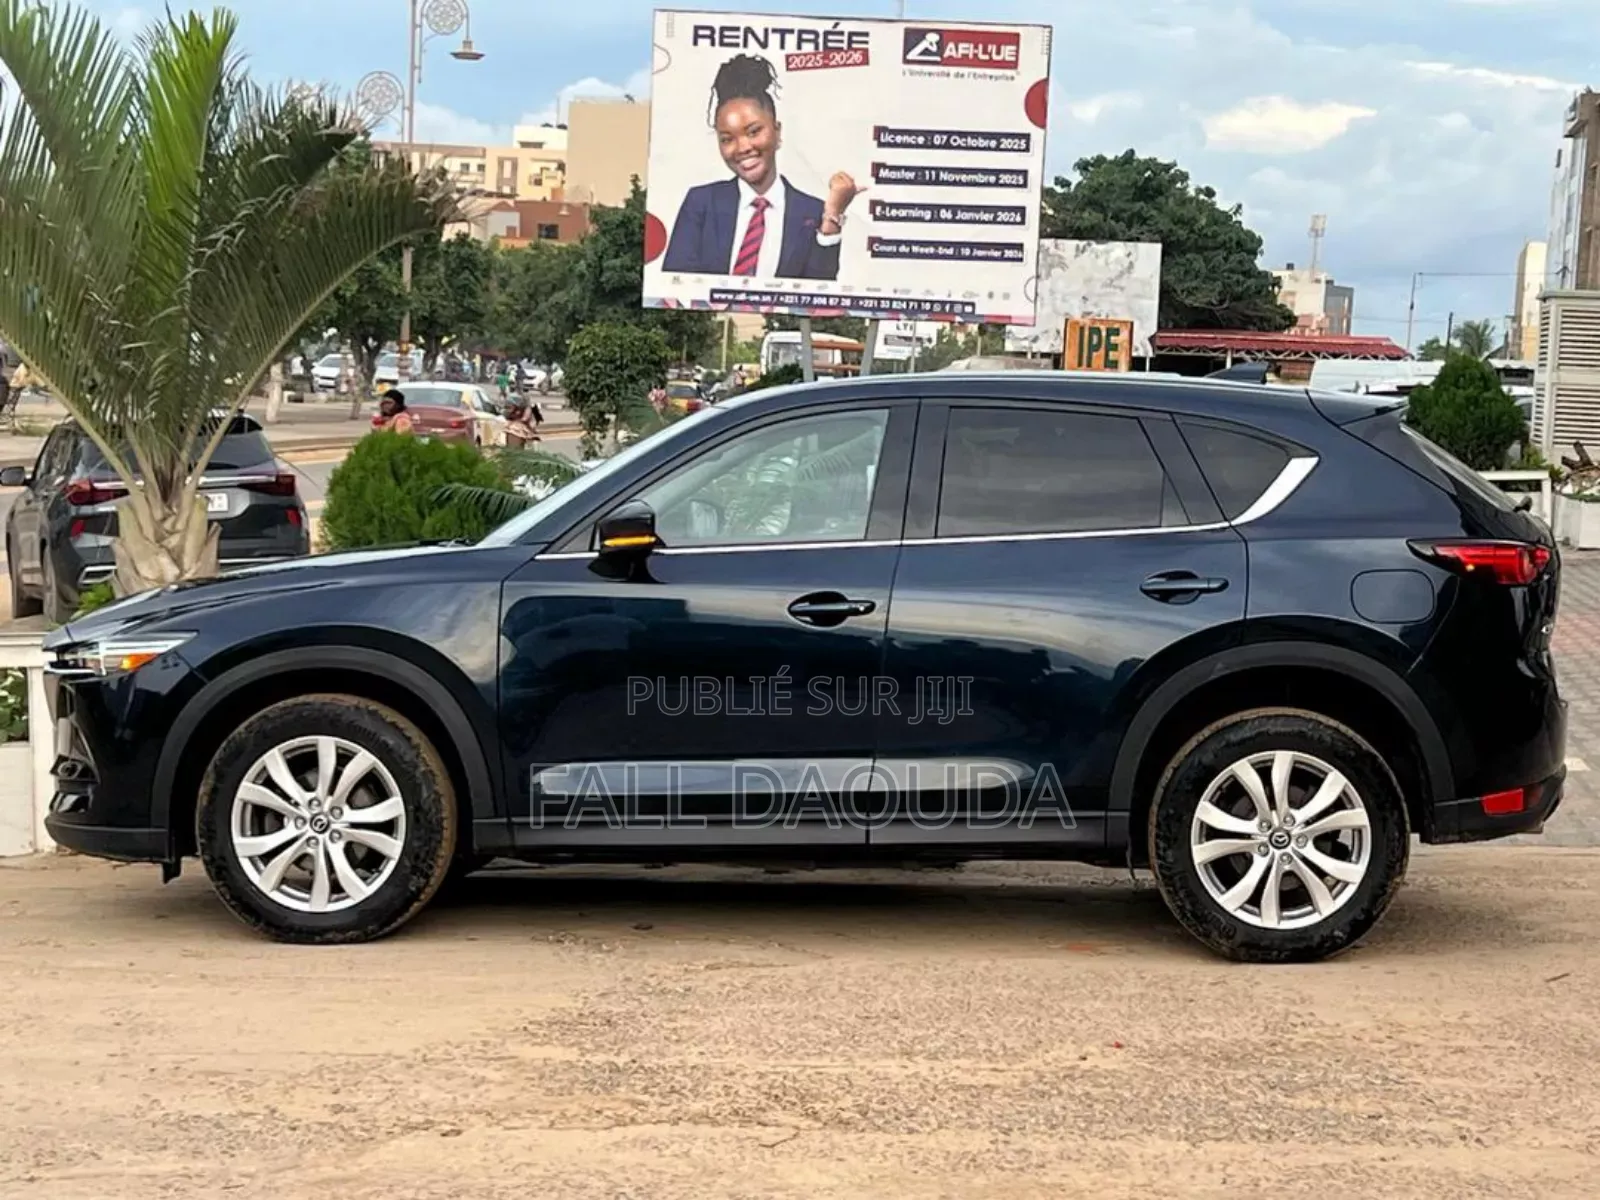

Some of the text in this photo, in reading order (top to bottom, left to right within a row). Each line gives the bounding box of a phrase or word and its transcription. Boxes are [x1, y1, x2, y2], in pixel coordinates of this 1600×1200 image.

[692, 22, 870, 51] RENTRÉE
[788, 51, 864, 69] 2025-2026
[880, 132, 925, 145] Licence
[933, 134, 947, 146] 07
[950, 135, 998, 149] Octobre
[999, 138, 1027, 150] 2025
[878, 168, 916, 180] Master
[925, 170, 936, 180] 11
[939, 171, 996, 184] Novembre
[998, 174, 1025, 185] 2025
[875, 206, 931, 221] E-Learning
[955, 209, 994, 222] Janvier
[996, 211, 1022, 223] 2026
[898, 244, 911, 253] du
[1077, 326, 1121, 368] IPE
